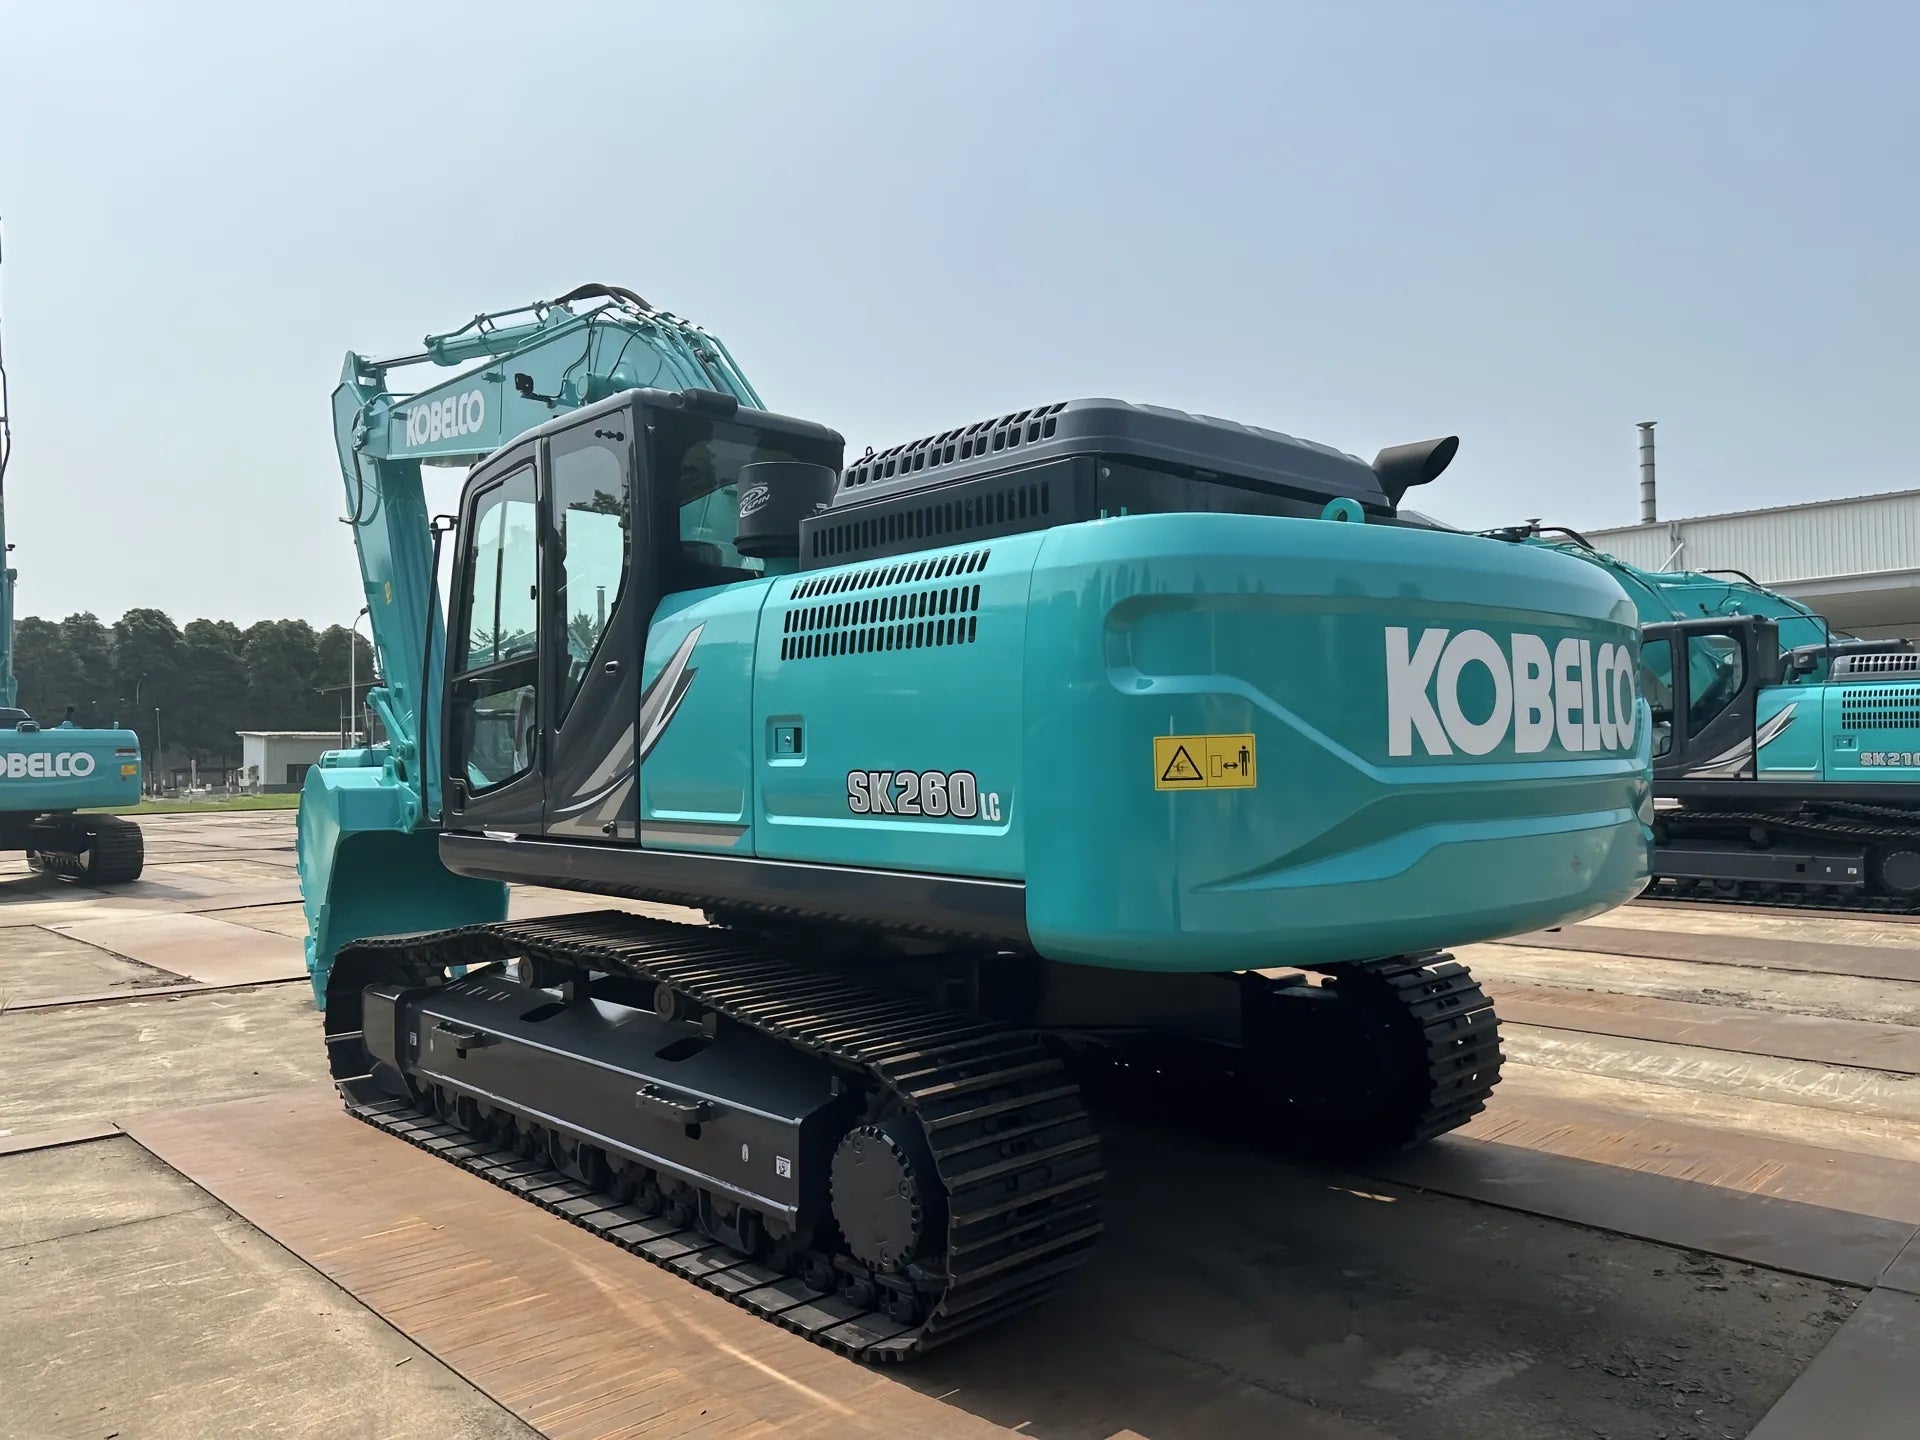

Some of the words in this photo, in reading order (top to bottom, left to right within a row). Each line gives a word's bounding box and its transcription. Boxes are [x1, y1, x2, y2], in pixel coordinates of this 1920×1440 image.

[406, 389, 485, 448] KOBELCO
[746, 494, 771, 511] SPIN
[1385, 626, 1637, 756] KOBELCO
[0, 752, 95, 778] BELCO
[847, 770, 978, 818] SK260
[979, 792, 1001, 822] LC
